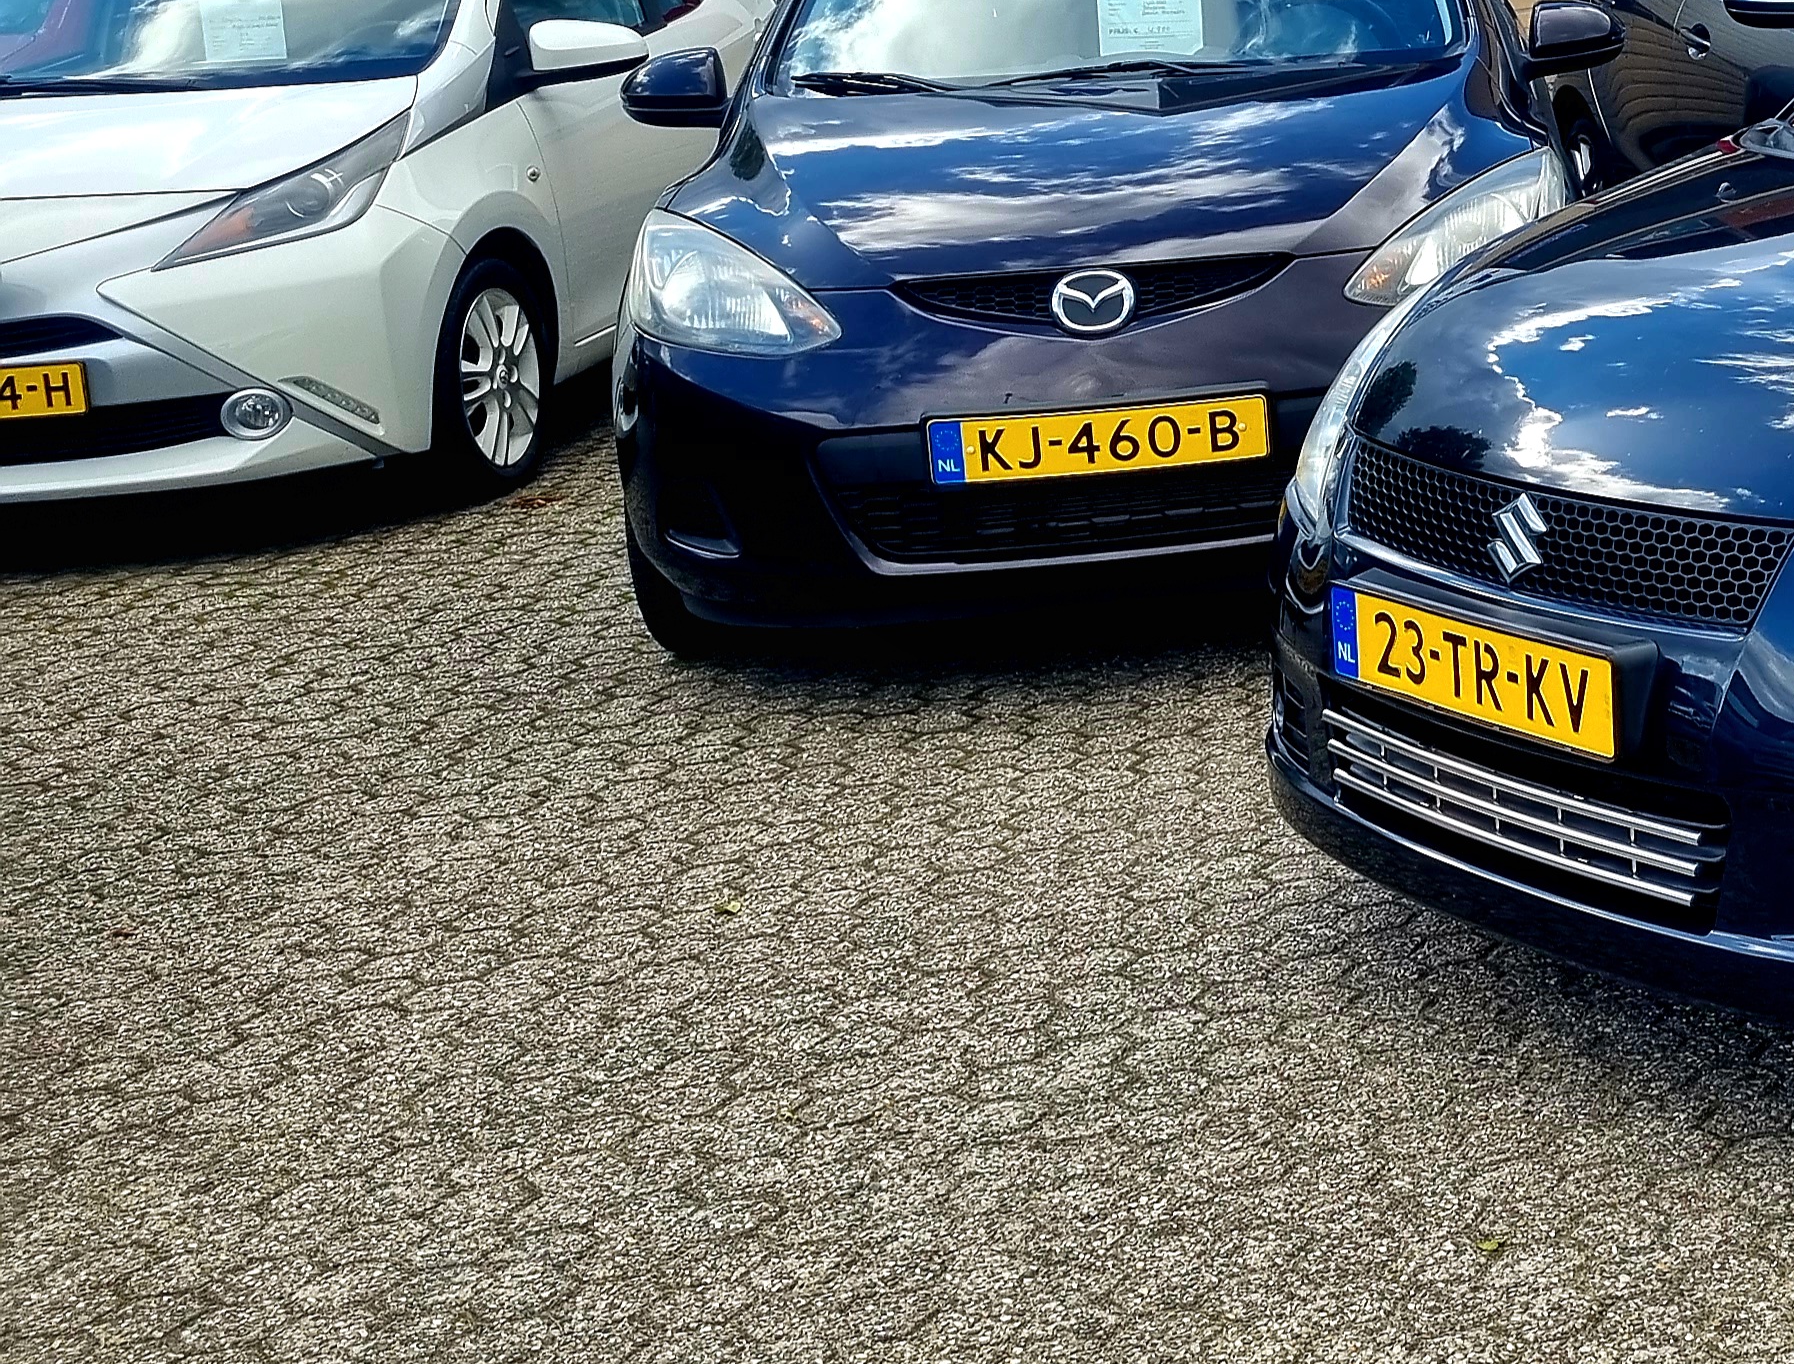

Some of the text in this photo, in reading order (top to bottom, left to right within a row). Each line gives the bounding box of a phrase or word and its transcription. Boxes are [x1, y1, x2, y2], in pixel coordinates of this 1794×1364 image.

[937, 409, 1240, 473] NL KJ-460-B
[1337, 611, 1589, 734] NL 23-TR-KV
